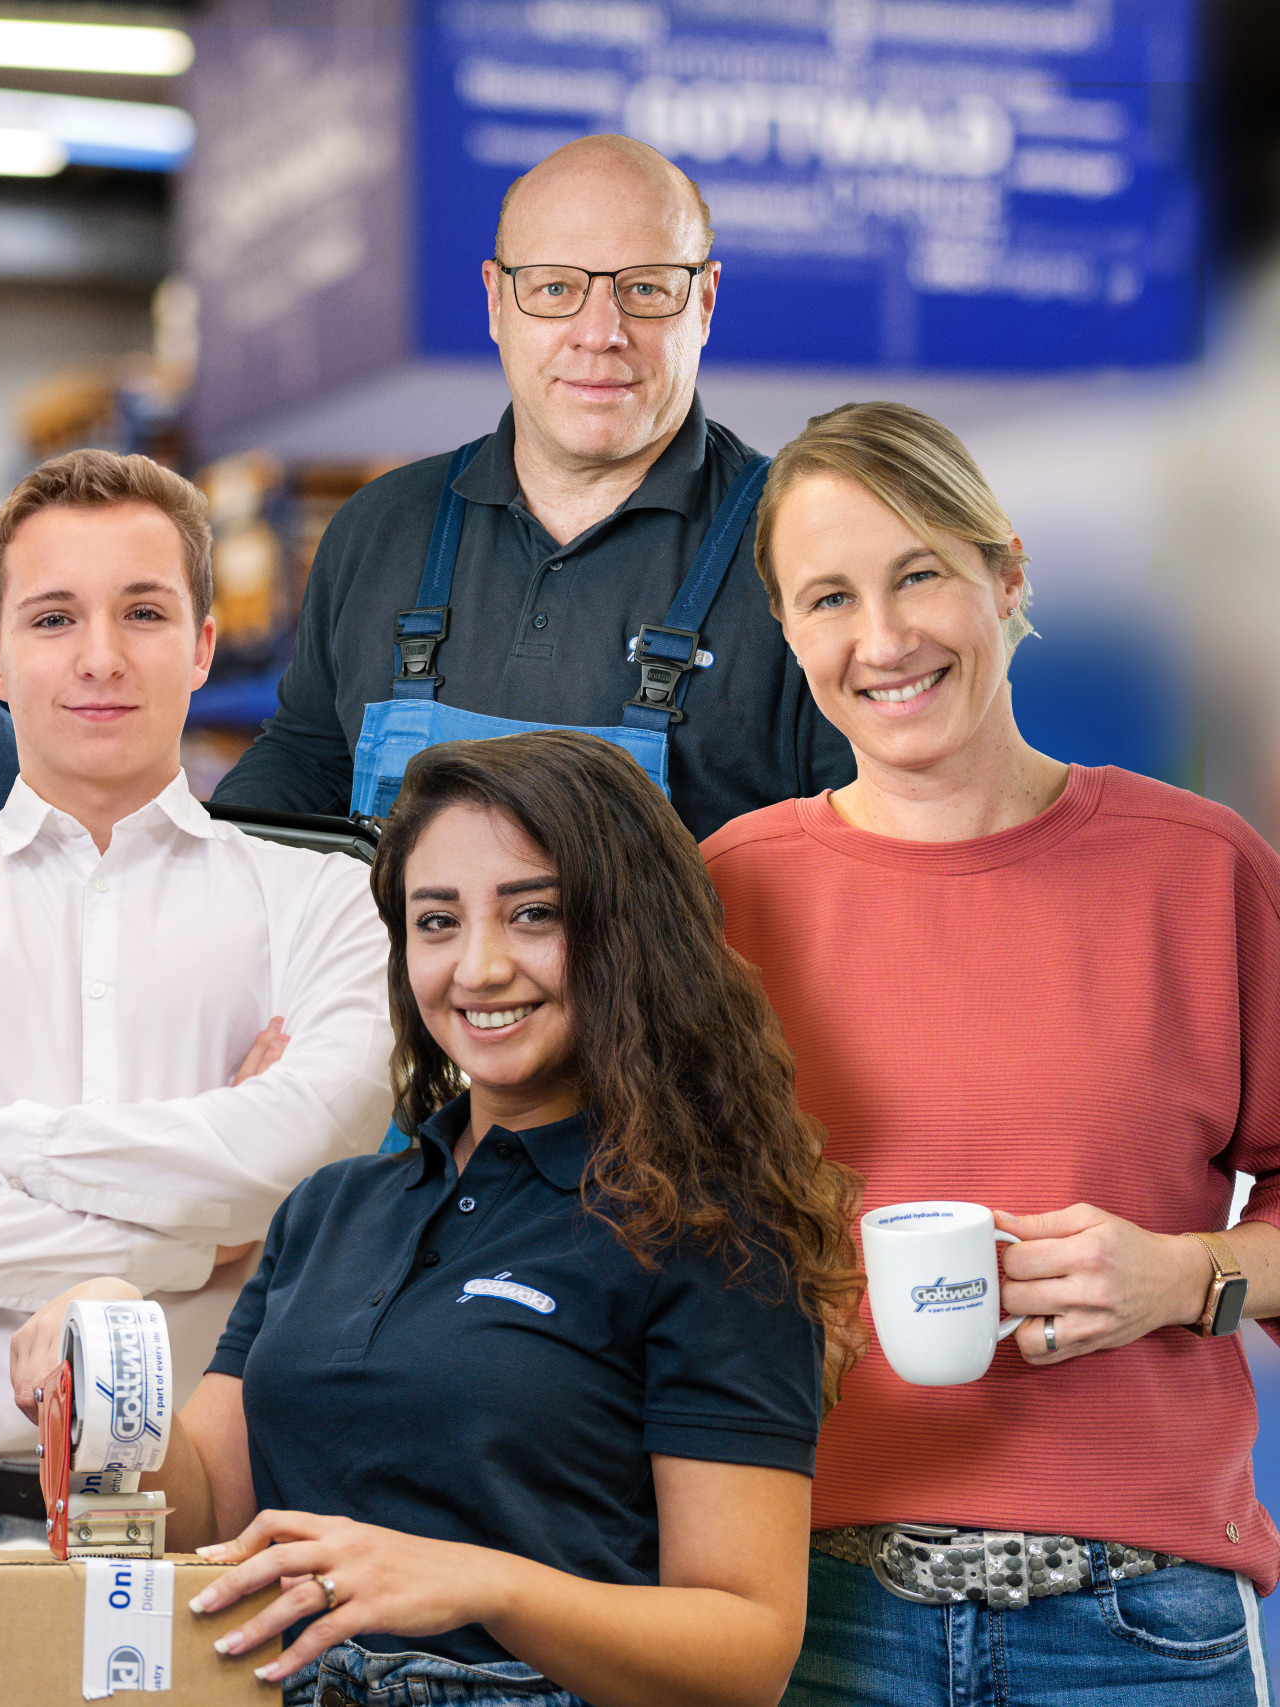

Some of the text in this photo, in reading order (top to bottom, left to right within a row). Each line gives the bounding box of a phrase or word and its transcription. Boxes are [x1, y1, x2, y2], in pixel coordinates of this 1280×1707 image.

[466, 1281, 548, 1308] Gottwald
[915, 1280, 984, 1302] Gottwald
[149, 1313, 161, 1343] indtry
[155, 1345, 164, 1371] every
[109, 1310, 142, 1439] Gottwald
[155, 1374, 164, 1385] of
[156, 1387, 165, 1408] part
